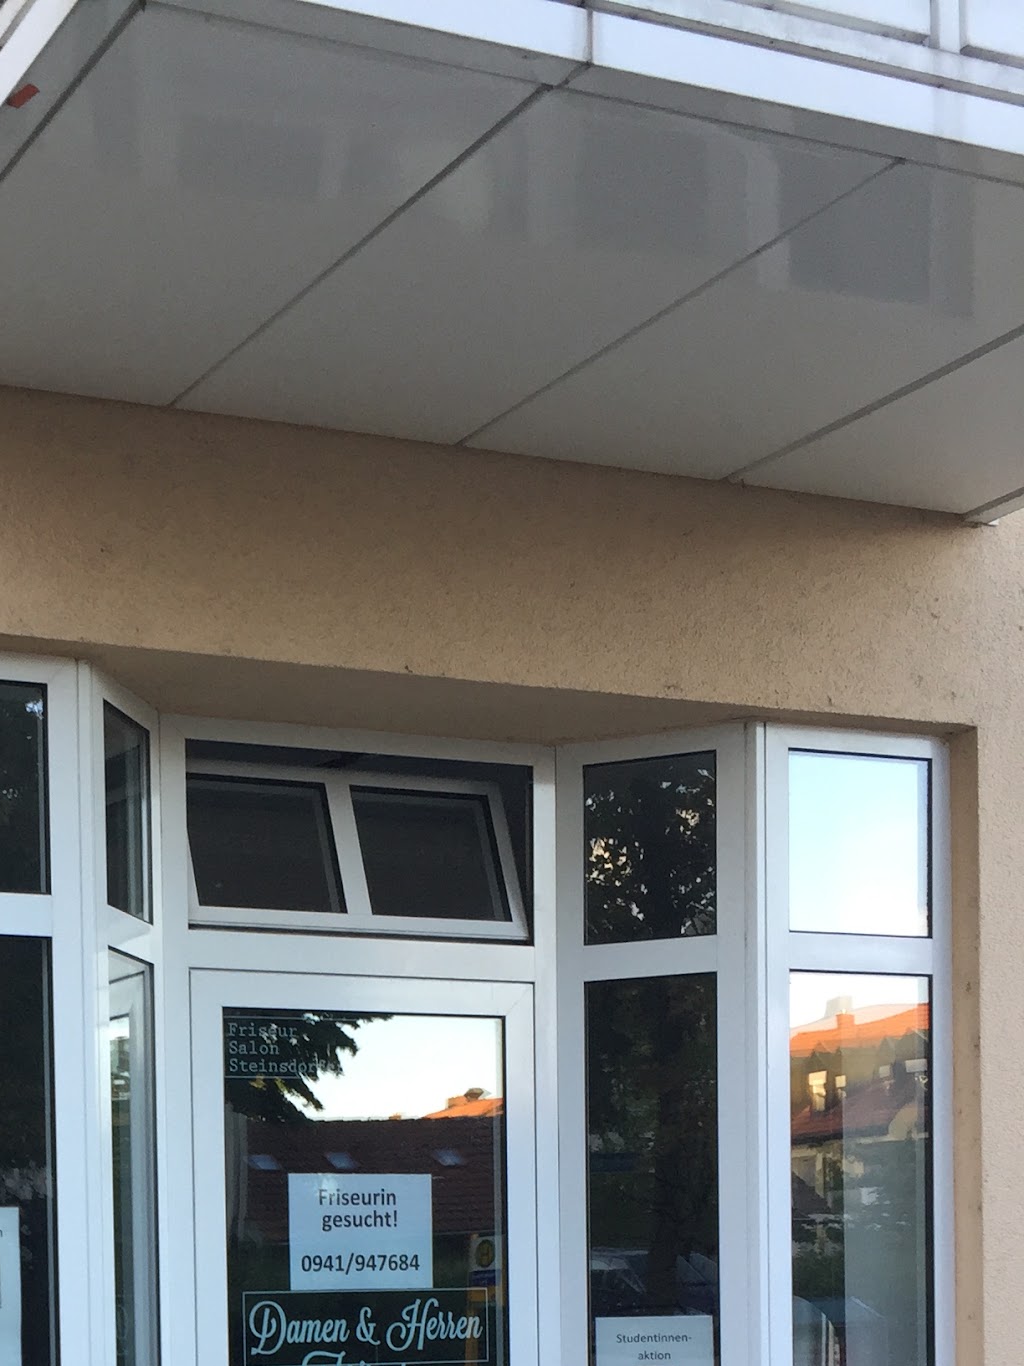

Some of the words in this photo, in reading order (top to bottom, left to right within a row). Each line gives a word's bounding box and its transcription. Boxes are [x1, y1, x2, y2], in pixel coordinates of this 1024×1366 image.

[228, 1022, 298, 1037] Friseur
[229, 1040, 280, 1055] Salon
[318, 1189, 397, 1207] Friseurin
[322, 1210, 398, 1232] gesucht!
[301, 1252, 421, 1276] 0941/947684
[249, 1299, 350, 1356] Damen
[356, 1306, 381, 1346] &
[386, 1296, 483, 1351] Herren
[616, 1331, 692, 1345] Studentinnen-
[637, 1350, 671, 1362] aktion
